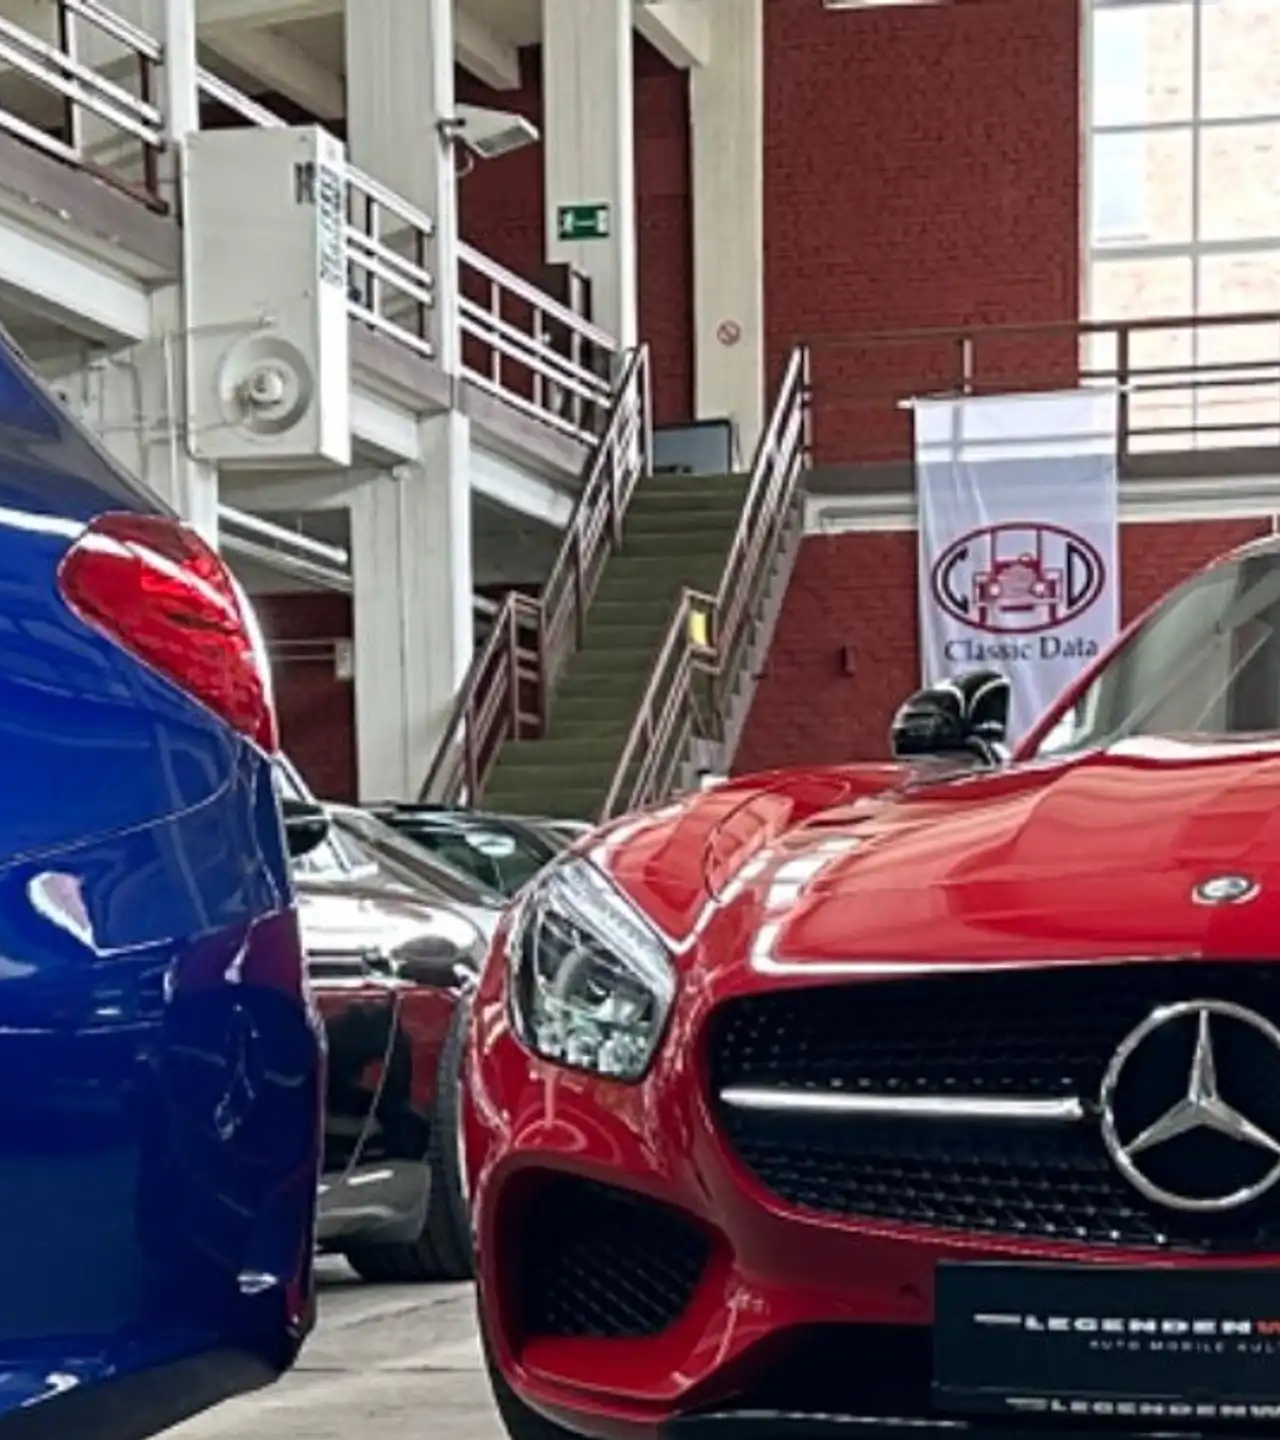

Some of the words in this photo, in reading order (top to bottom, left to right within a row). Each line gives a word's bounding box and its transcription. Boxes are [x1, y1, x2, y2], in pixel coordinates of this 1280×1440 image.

[944, 638, 1035, 662] Classic
[1038, 635, 1099, 661] Data
[1088, 1340, 1141, 1351] AUTO
[1149, 1340, 1225, 1353] MOBILE
